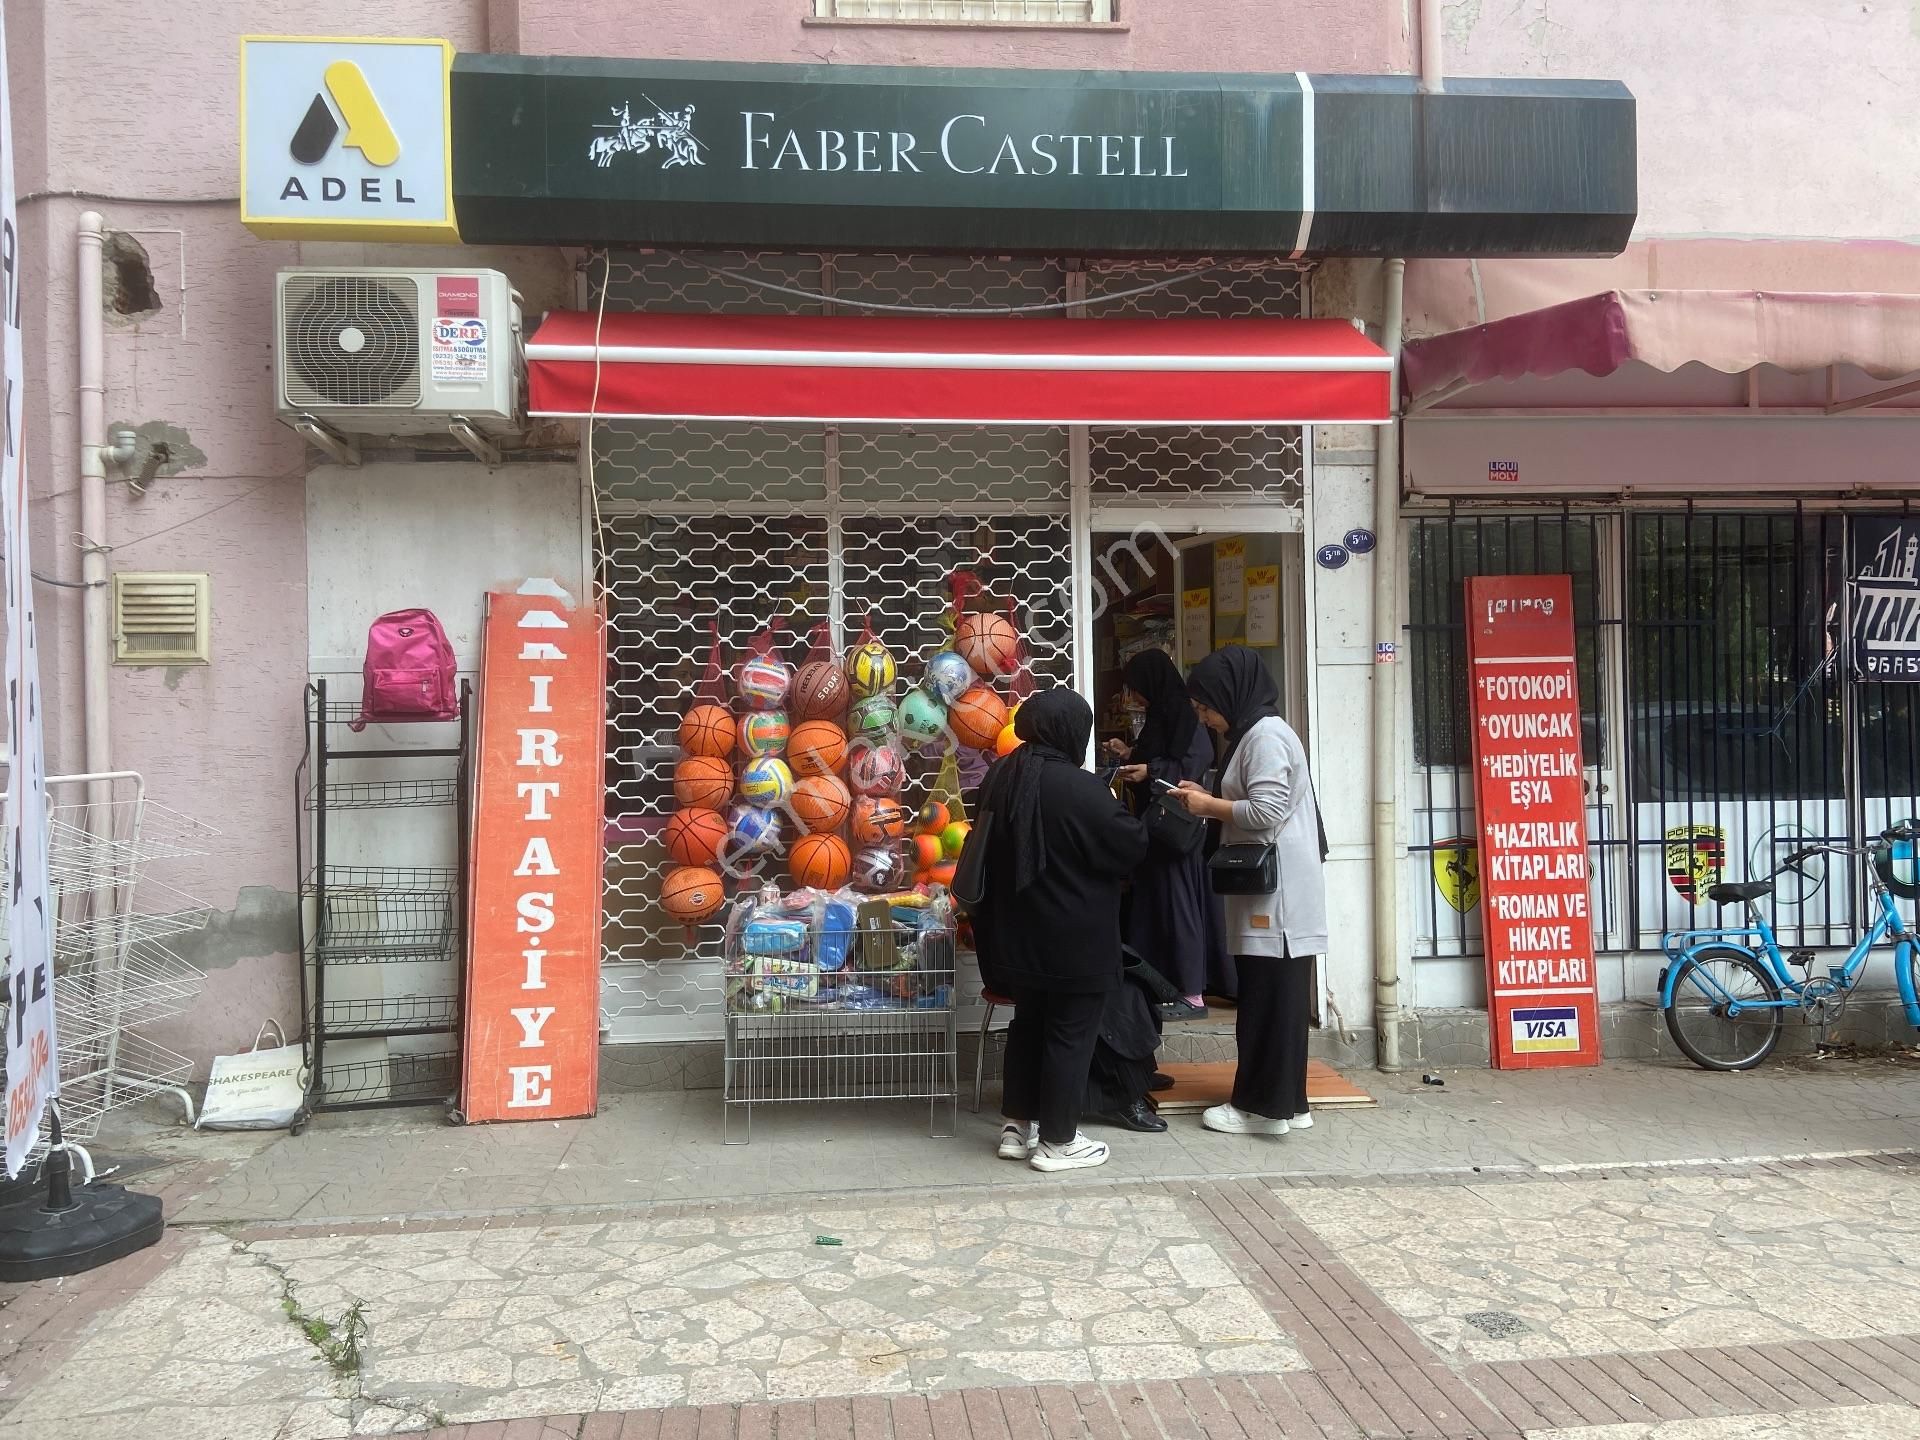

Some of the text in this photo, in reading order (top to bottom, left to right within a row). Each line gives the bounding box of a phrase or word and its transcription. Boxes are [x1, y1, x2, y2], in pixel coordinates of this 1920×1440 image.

[740, 111, 1189, 178] FABER-CASTELL
[280, 176, 416, 203] ADEL
[440, 326, 479, 339] DERE
[1490, 462, 1517, 471] LIQUI
[1490, 471, 1517, 481] MOLY
[817, 671, 840, 701] SPORT
[1510, 780, 1552, 810] EŞYA
[1491, 849, 1585, 882] KİTAPLARI
[1563, 893, 1587, 918] VE
[1509, 921, 1572, 952] HİKAYE
[1498, 954, 1587, 985] KİTAPLARI
[1525, 1021, 1567, 1038] VISA
[208, 1068, 294, 1087] SHAKESPEARE
